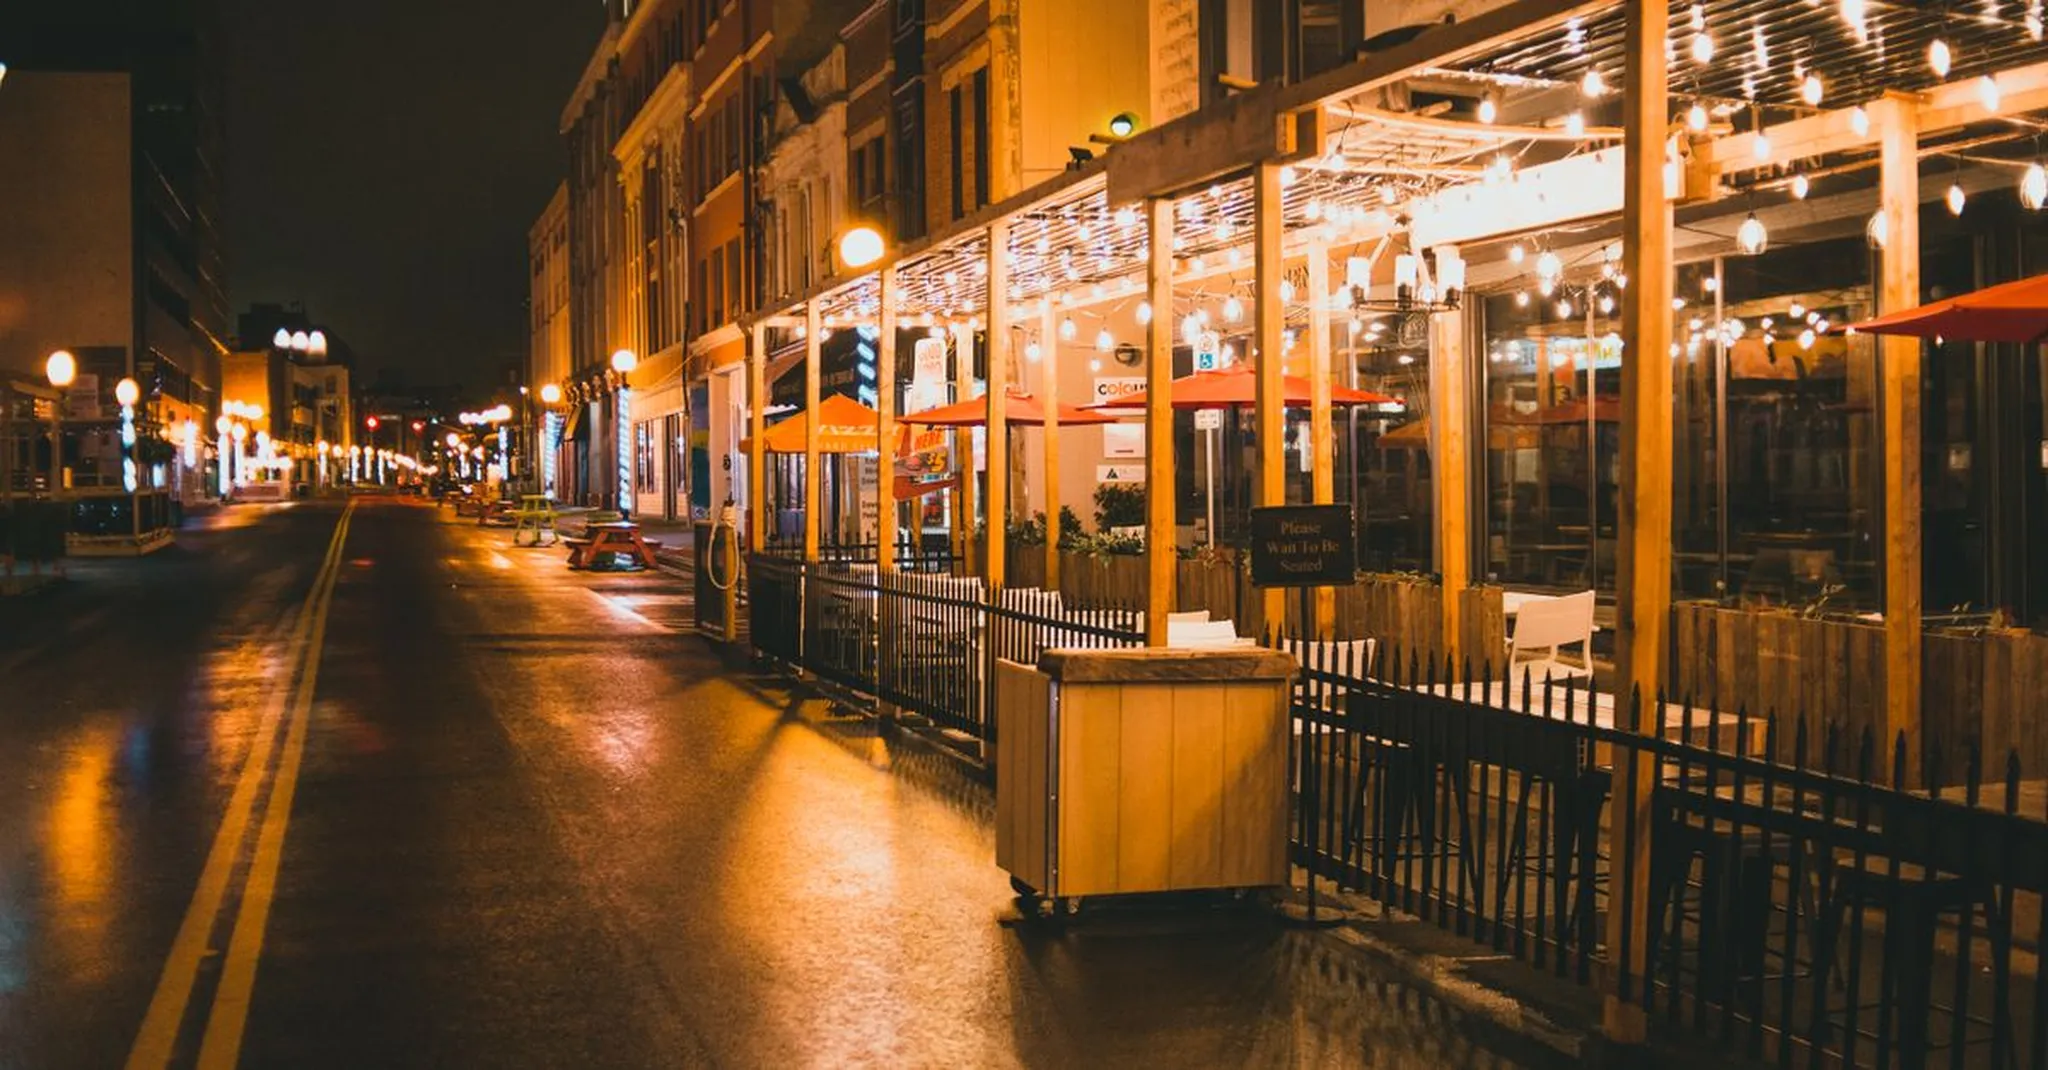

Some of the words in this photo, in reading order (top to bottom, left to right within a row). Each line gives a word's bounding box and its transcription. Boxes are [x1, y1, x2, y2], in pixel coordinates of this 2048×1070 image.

[1281, 520, 1322, 536] Please
[1266, 540, 1297, 554] Wait
[1300, 540, 1319, 553] To
[1322, 538, 1340, 553] Be
[1280, 556, 1323, 573] Seated
